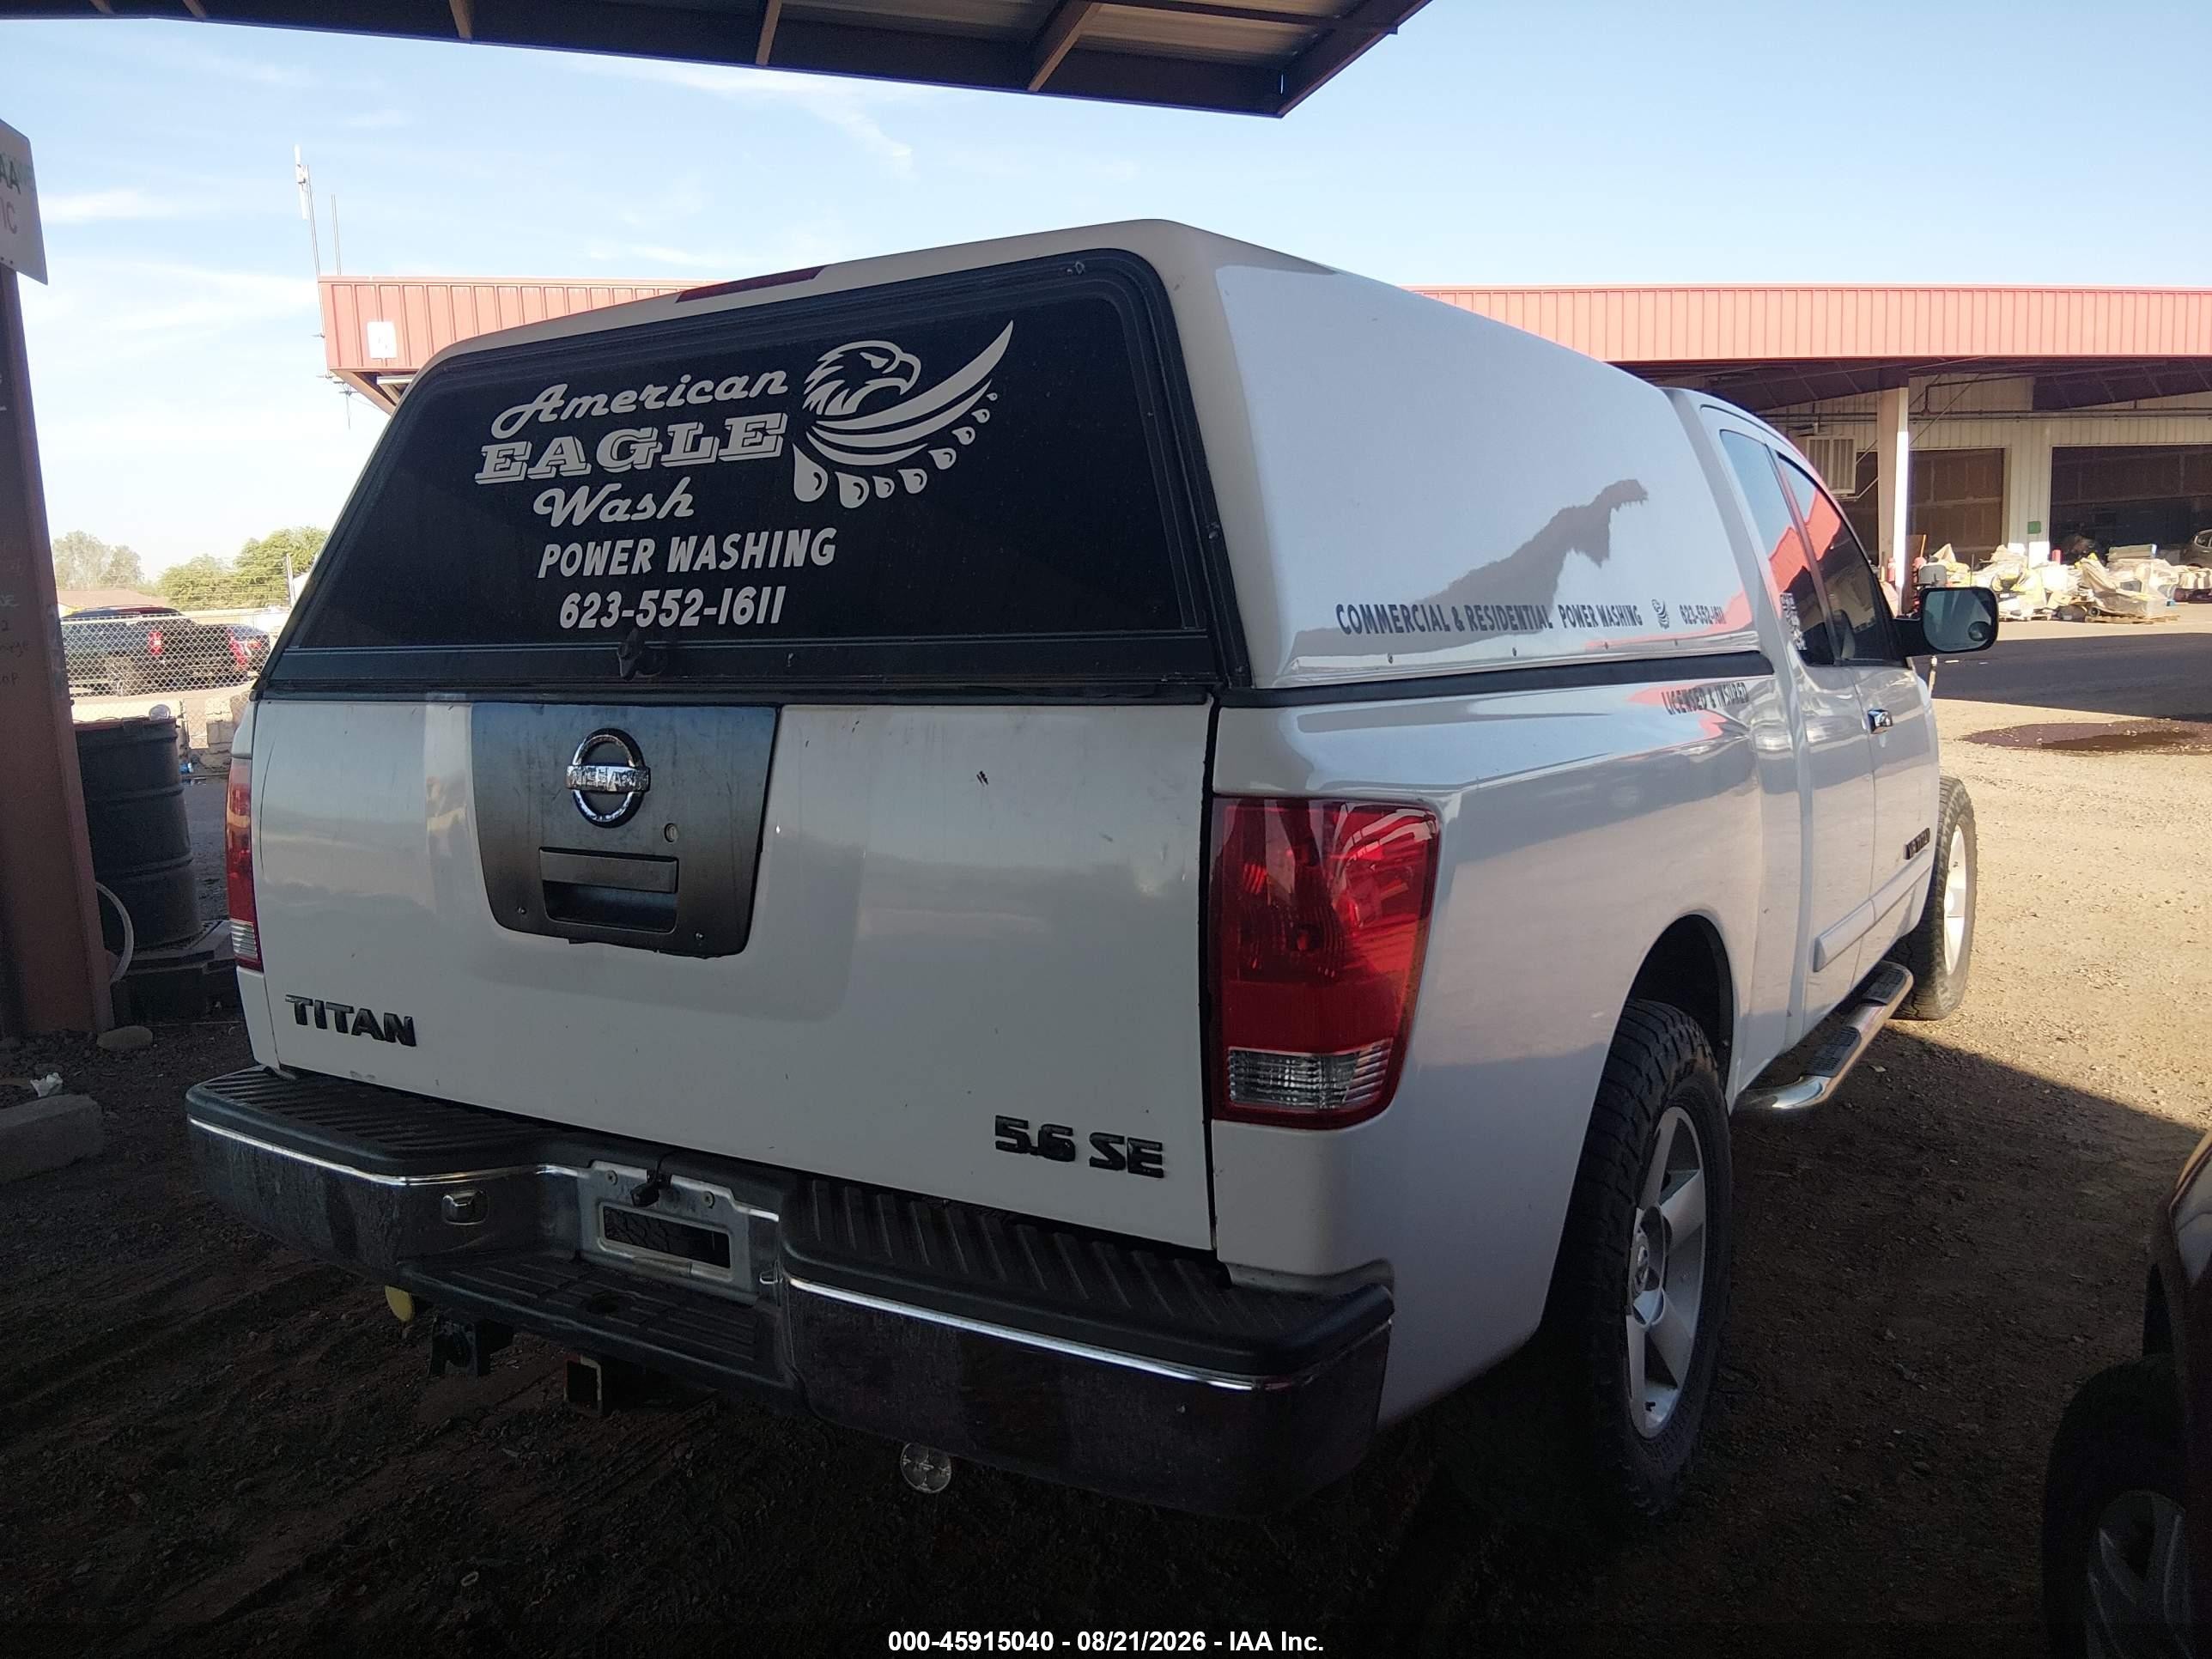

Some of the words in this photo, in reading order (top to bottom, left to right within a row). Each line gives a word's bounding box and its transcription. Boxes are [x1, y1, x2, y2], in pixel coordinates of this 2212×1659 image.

[490, 369, 789, 440] American
[474, 412, 788, 484] EAGLE
[532, 476, 695, 527] Wash
[538, 538, 656, 579] POWER
[667, 527, 837, 573] WASHING
[559, 585, 787, 629] 623-552-1611
[1335, 604, 1451, 635] COMMERCIAL
[1451, 605, 1464, 632] &
[1464, 604, 1553, 632] RESIDENTIAL
[1557, 604, 1599, 629] POWER
[1595, 604, 1644, 628] WASHING
[284, 994, 417, 1047] TITAN
[994, 1115, 1076, 1163] 5.6
[1089, 1132, 1164, 1179] SE
